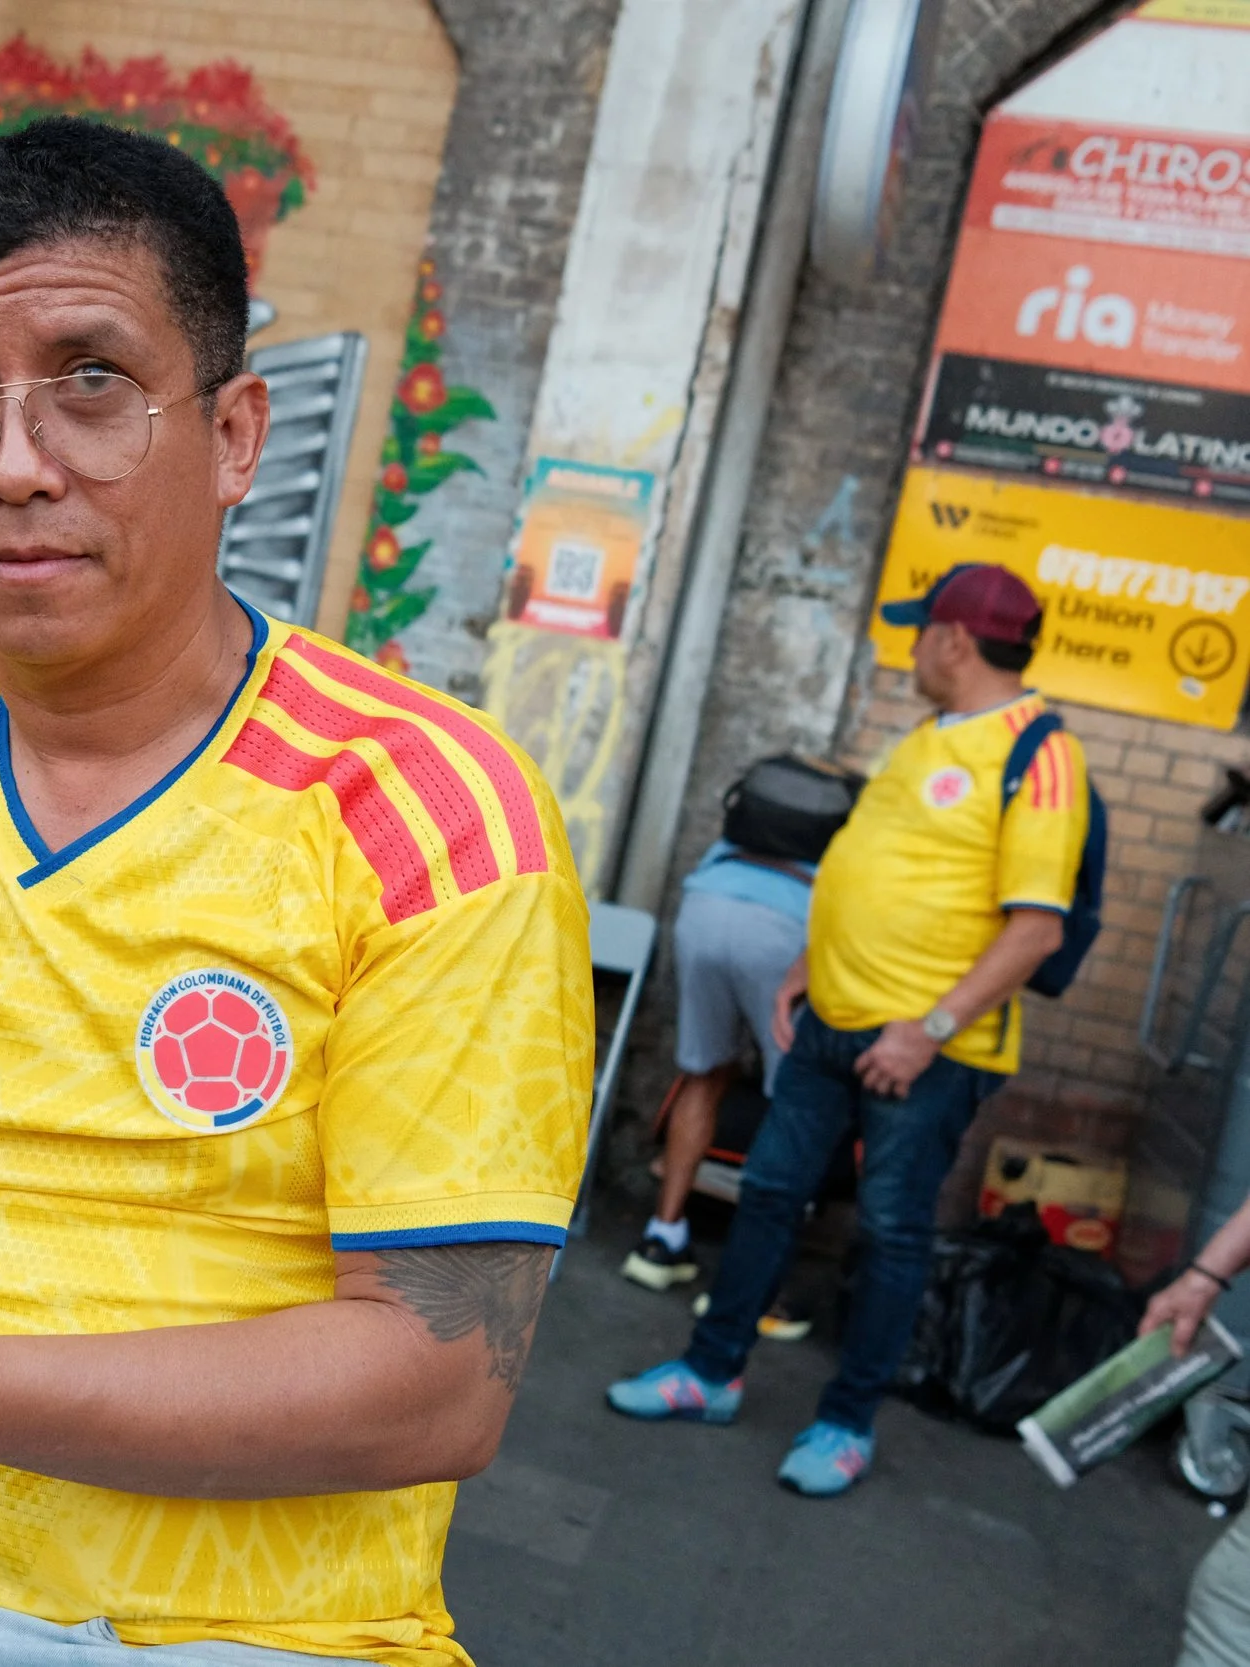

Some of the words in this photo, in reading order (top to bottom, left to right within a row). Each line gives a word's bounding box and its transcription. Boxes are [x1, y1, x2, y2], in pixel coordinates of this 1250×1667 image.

[1016, 267, 1135, 347] ria
[965, 404, 1099, 446] MUNDO
[1057, 594, 1156, 632] Union
[1053, 633, 1132, 665] here
[177, 973, 251, 995] COLOMBIANA
[250, 989, 265, 1006] DE
